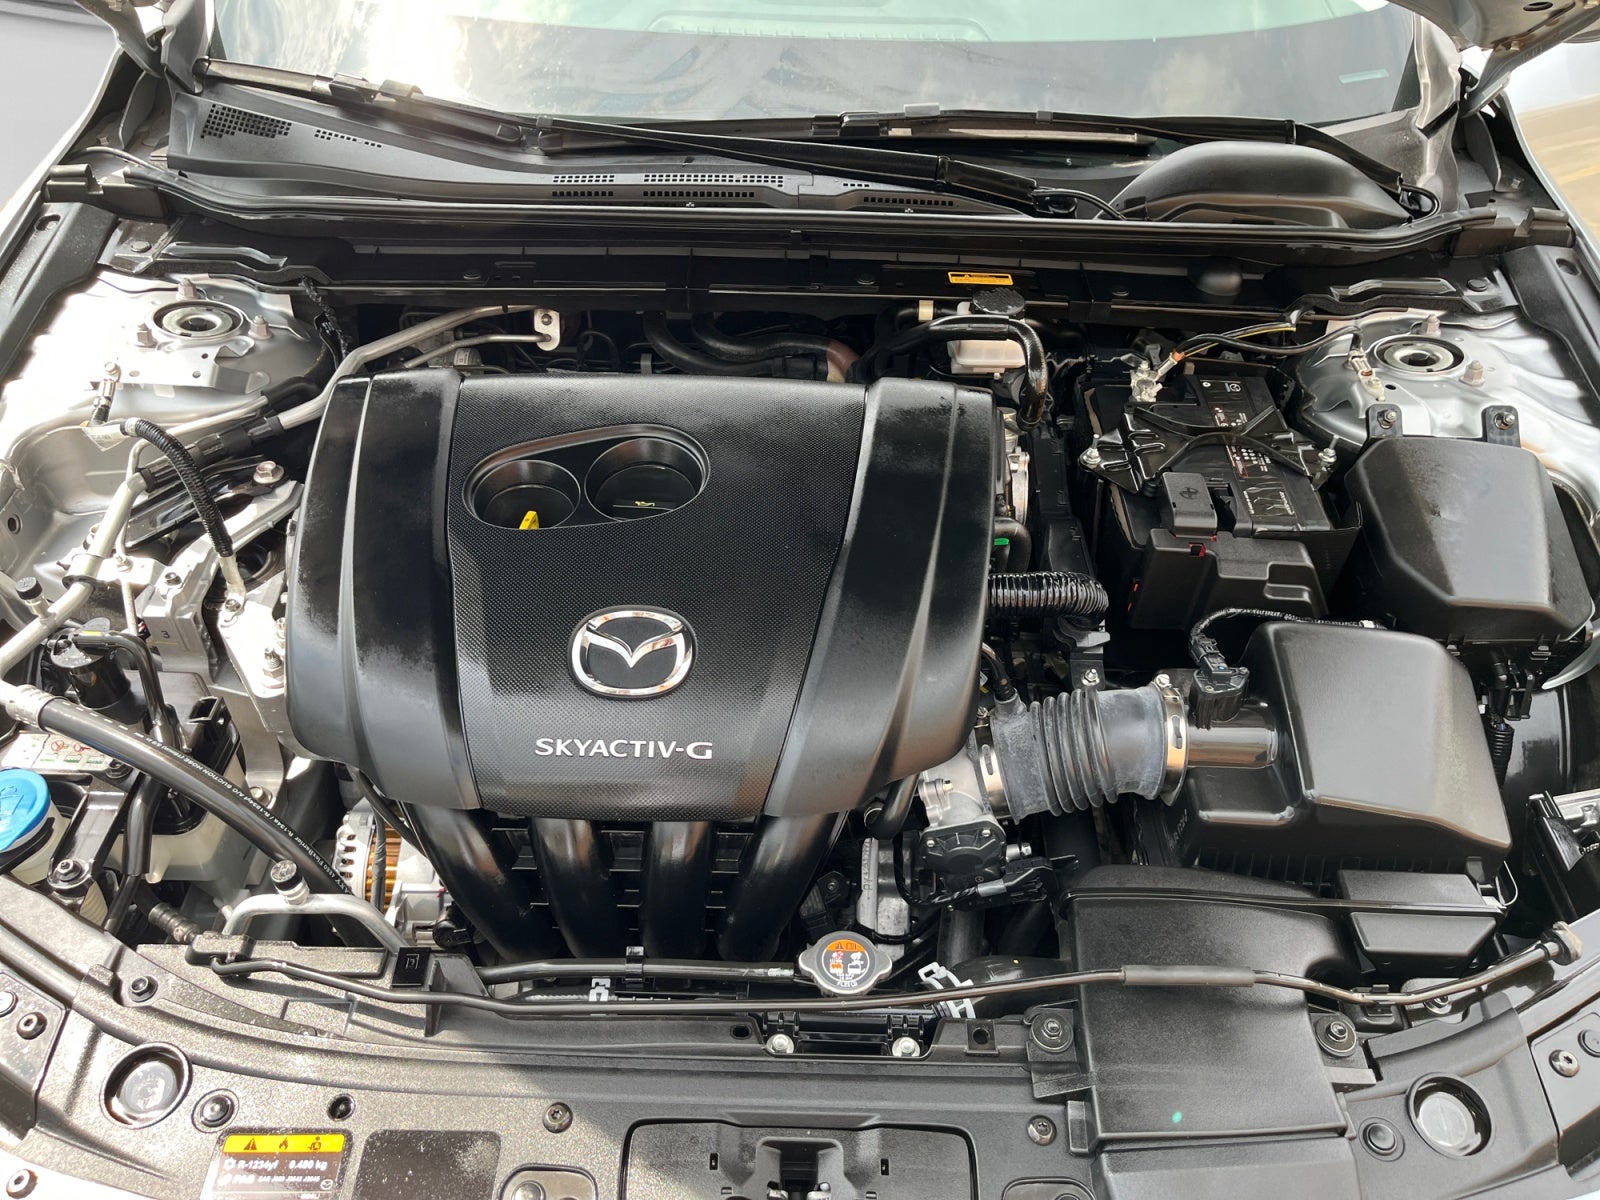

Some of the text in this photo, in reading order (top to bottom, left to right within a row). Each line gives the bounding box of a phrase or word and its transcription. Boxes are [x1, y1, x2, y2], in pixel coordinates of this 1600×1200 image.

[534, 737, 713, 760] SKYACTIV-G
[183, 757, 202, 770] HOSE
[202, 769, 232, 789] SUCTION
[273, 818, 293, 837] R-134a
[237, 1159, 280, 1172] R-1234yf
[315, 1159, 328, 1172] kg
